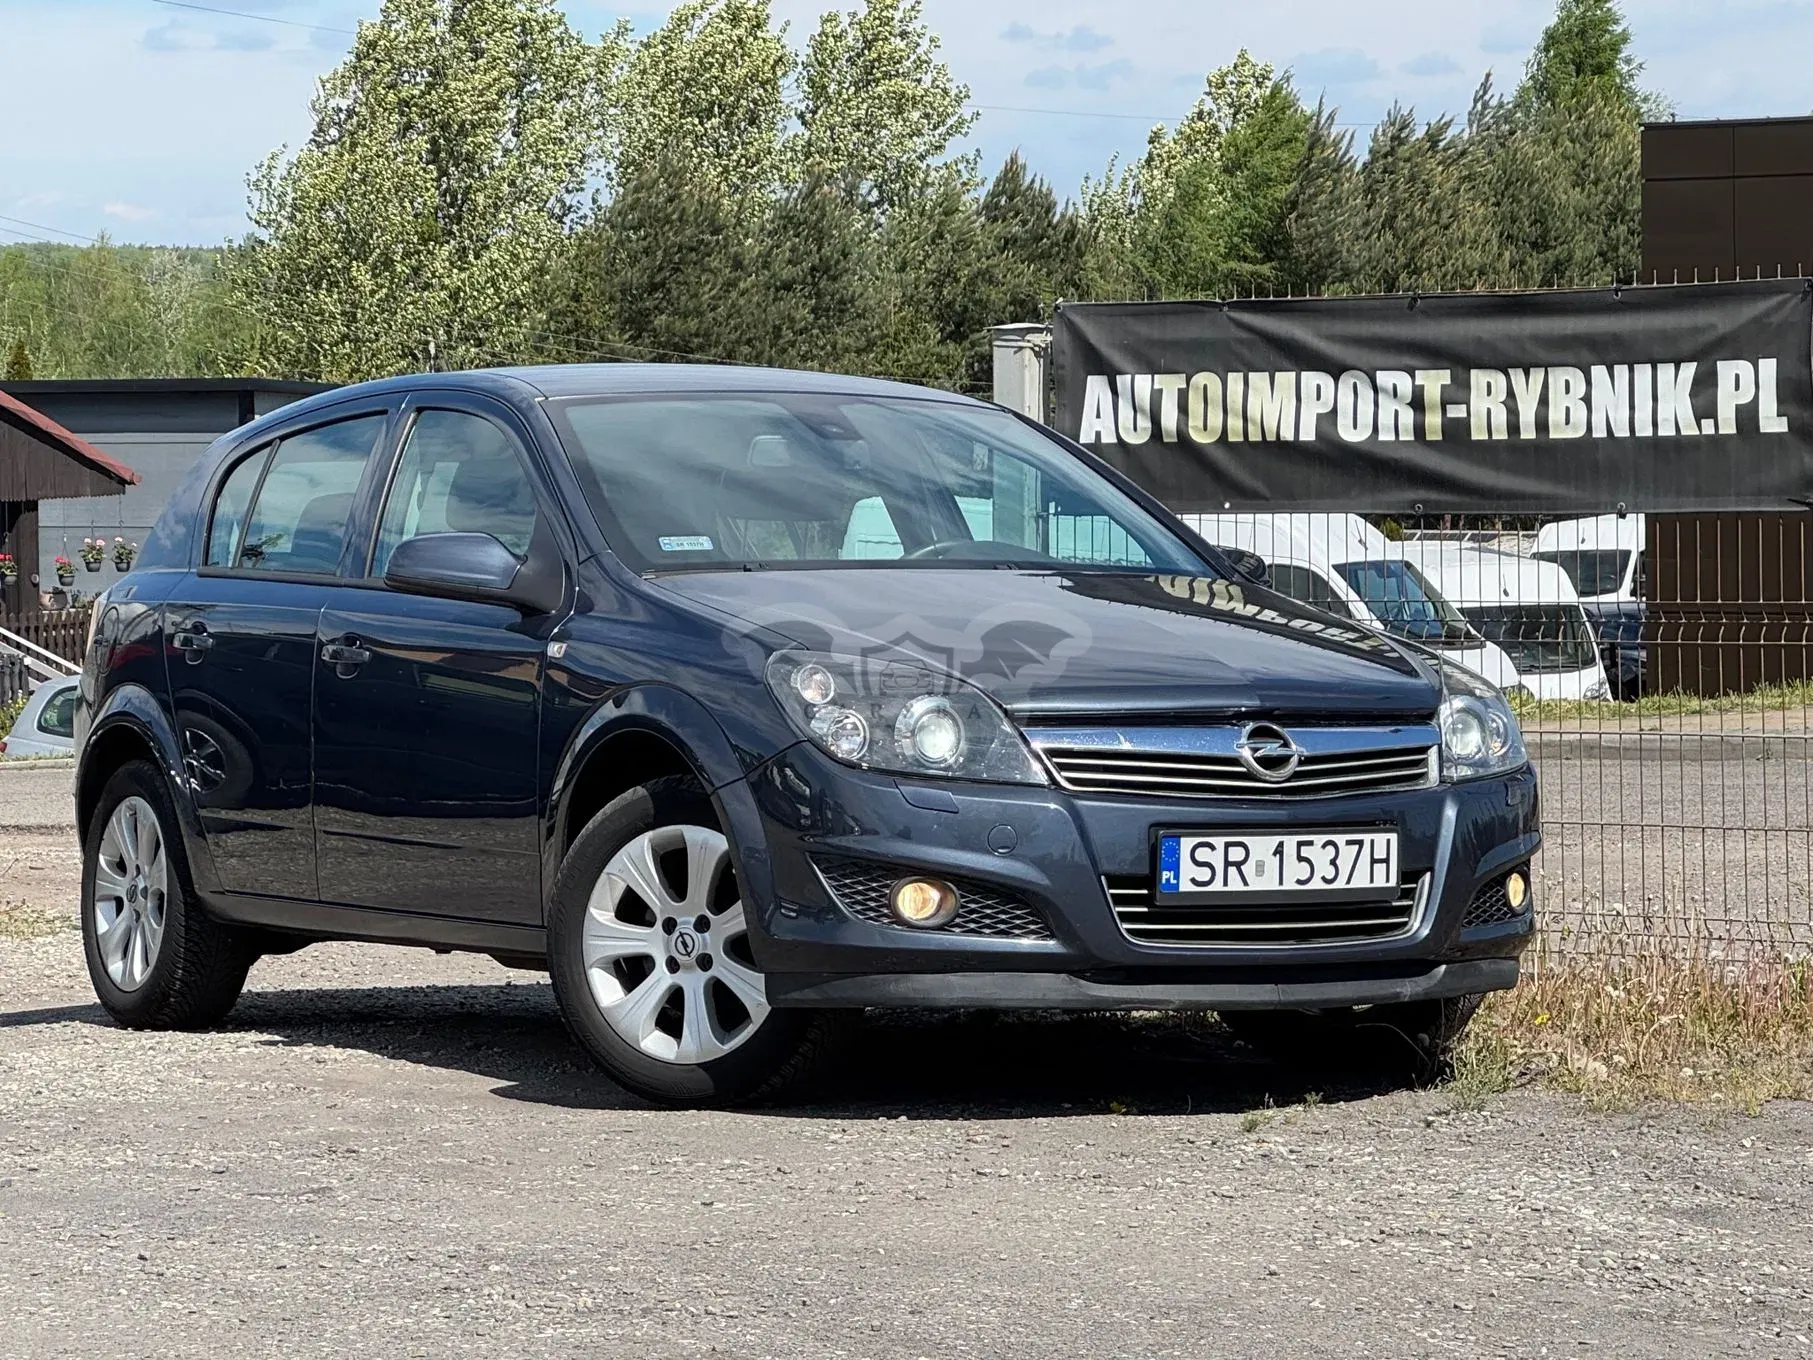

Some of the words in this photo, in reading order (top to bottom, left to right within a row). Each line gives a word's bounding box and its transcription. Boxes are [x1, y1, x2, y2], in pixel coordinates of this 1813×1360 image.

[1079, 358, 1788, 444] AUTOIMPORT-RYBNIK.PL
[1162, 871, 1177, 884] PL
[1189, 840, 1250, 887] SR
[1272, 838, 1391, 887] 1537H
